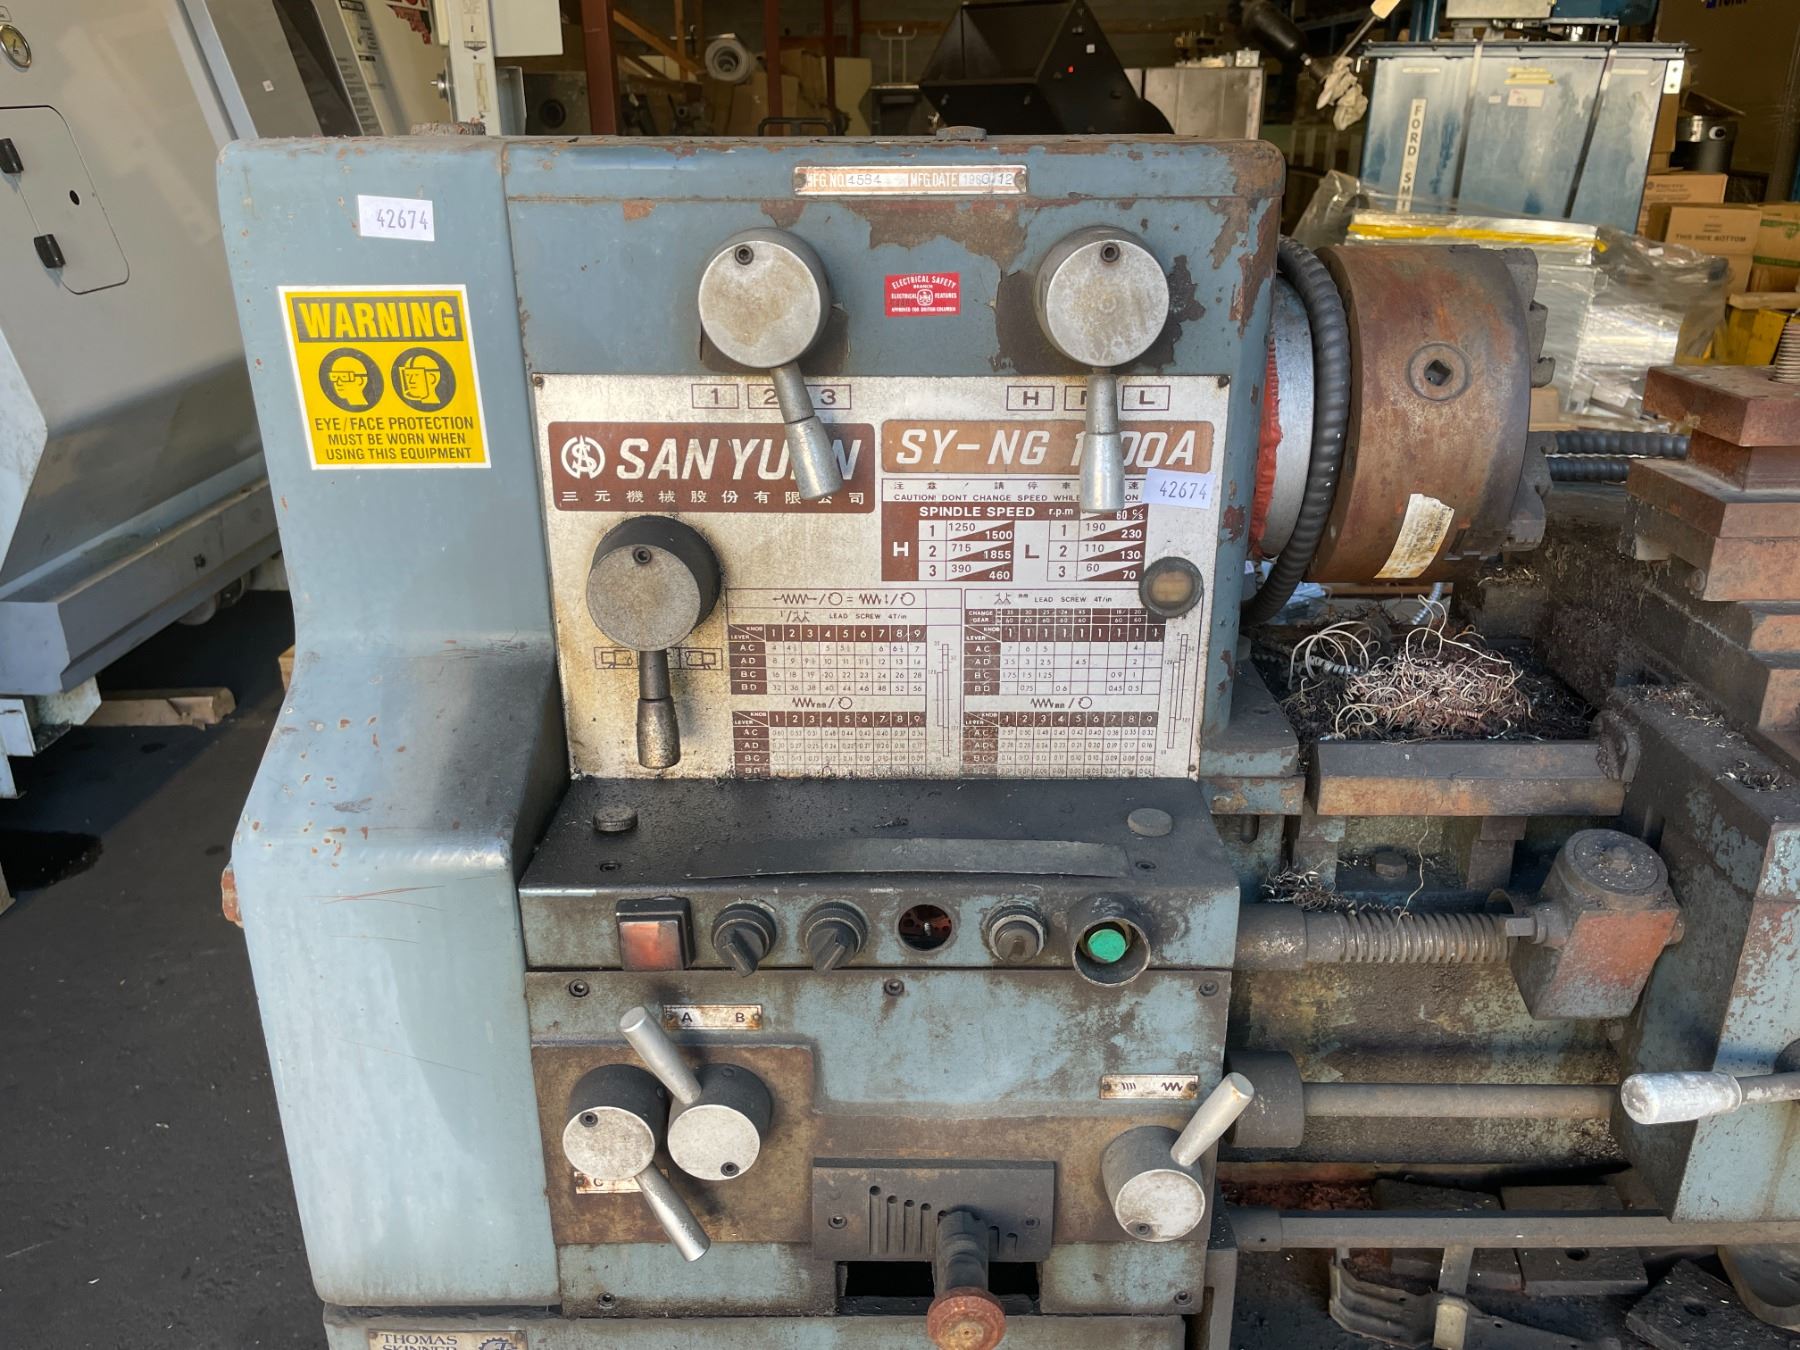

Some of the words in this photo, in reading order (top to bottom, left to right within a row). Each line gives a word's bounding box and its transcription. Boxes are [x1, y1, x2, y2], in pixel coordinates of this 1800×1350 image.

[1408, 104, 1422, 157] FORD
[376, 208, 429, 230] 42674
[891, 276, 930, 290] ELECTRICAL
[931, 276, 957, 289] SAFETY
[298, 302, 456, 339] WARNING
[712, 389, 720, 405] 1
[764, 389, 777, 406] 2
[820, 388, 836, 406] 3
[1023, 390, 1039, 406] H
[1140, 390, 1156, 406] L
[389, 416, 474, 430] PROTECTION
[328, 434, 364, 446] MUST
[368, 434, 384, 445] BE
[386, 433, 425, 445] WORN
[428, 432, 466, 444] WHEN
[326, 448, 365, 461] USING
[368, 448, 398, 460] THIS
[400, 448, 472, 460] EQUIPMENT
[1070, 430, 1196, 468] 100A
[616, 438, 720, 480] SAN
[727, 438, 862, 480] YUN
[1159, 480, 1208, 500] 42674
[920, 506, 982, 517] SPINDLE
[986, 506, 1036, 517] SPEED
[1048, 508, 1074, 516] r.p.m
[1116, 510, 1128, 520] 60
[930, 524, 936, 537] 1
[948, 522, 976, 532] 1250
[1062, 524, 1067, 536] 1
[1086, 522, 1106, 532] 190
[985, 530, 1013, 540] 1500
[1120, 530, 1142, 538] 230
[892, 542, 909, 557] H
[928, 545, 936, 558] 2
[952, 544, 972, 552] 715
[1024, 544, 1040, 558] L
[1059, 545, 1068, 558] 2
[1084, 544, 1104, 552] 110
[983, 550, 1012, 560] 1855
[1120, 550, 1141, 560] 130
[929, 564, 936, 577] 3
[951, 564, 972, 573] 390
[1058, 566, 1066, 578] 3
[1086, 563, 1100, 572] 60
[988, 570, 1010, 580] 460
[1122, 570, 1137, 580] 70
[772, 628, 776, 638] 1
[789, 628, 796, 638] 2
[807, 629, 814, 638] 3
[824, 630, 831, 638] 4
[842, 630, 848, 638] 5
[860, 630, 866, 638] 6
[880, 630, 885, 638] 7
[896, 629, 902, 638] 8
[914, 630, 920, 638] 9
[792, 714, 798, 723] 2
[810, 715, 815, 723] 3
[844, 715, 850, 723] 5
[862, 715, 868, 723] 6
[880, 715, 886, 723] 7
[1022, 714, 1028, 722] 2
[1041, 715, 1046, 723] 3
[680, 1012, 694, 1023] A
[735, 1012, 746, 1023] B
[592, 1178, 604, 1188] C
[380, 1334, 458, 1346] THOMAS
